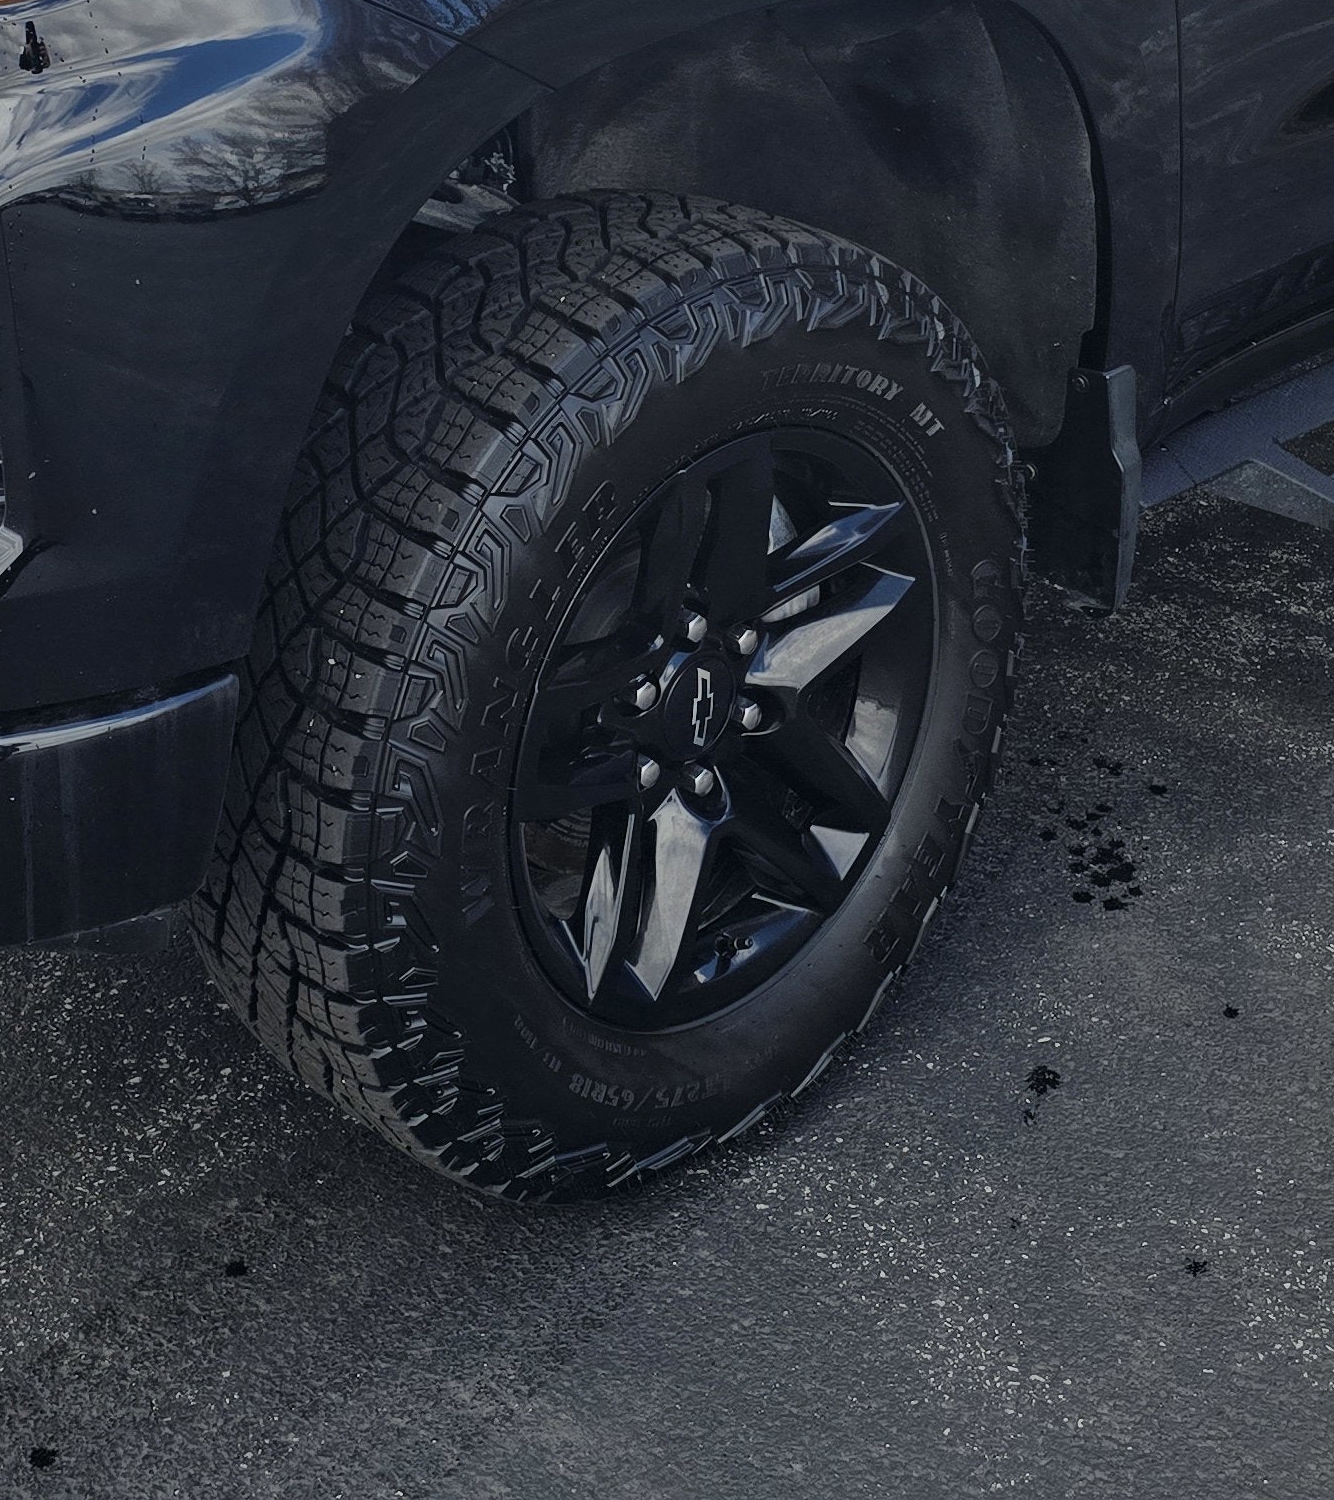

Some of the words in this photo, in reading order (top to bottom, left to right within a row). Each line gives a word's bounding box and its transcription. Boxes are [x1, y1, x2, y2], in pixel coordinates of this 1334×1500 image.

[762, 363, 904, 402] TERRITORY
[908, 402, 946, 438] MT
[460, 479, 619, 928] WRANGLER
[863, 558, 1004, 964] GOODYEAR
